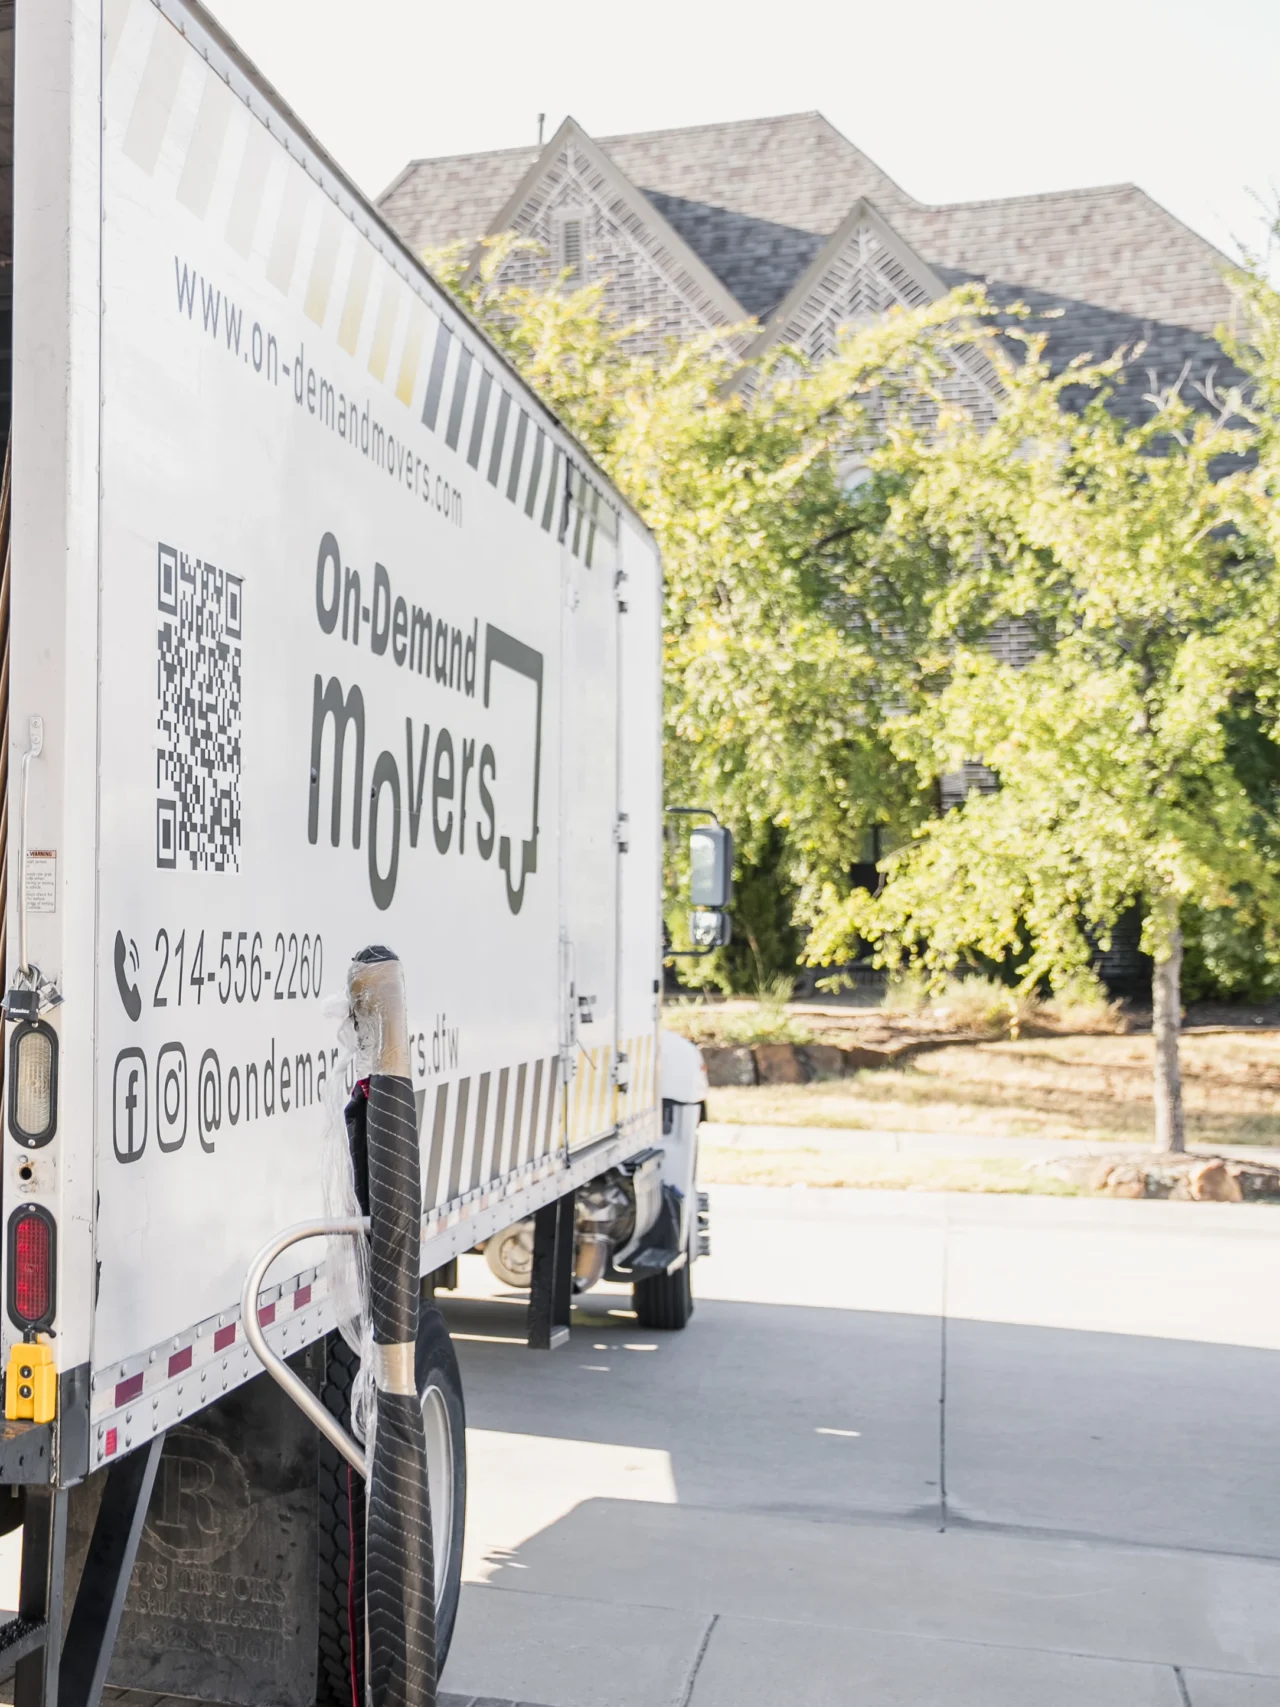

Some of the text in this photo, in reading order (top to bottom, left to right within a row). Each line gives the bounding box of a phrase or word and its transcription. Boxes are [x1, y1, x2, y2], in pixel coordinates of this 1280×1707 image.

[174, 255, 463, 528] www.on-demandmovers.com
[315, 531, 479, 698] On-Demand
[153, 927, 323, 1008] 214-556-2260
[197, 1012, 459, 1154] @ondemars.dfw
[129, 1561, 287, 1605] Y'S TRUCKS
[136, 1591, 190, 1620] Sales
[215, 1600, 296, 1640] Leasing
